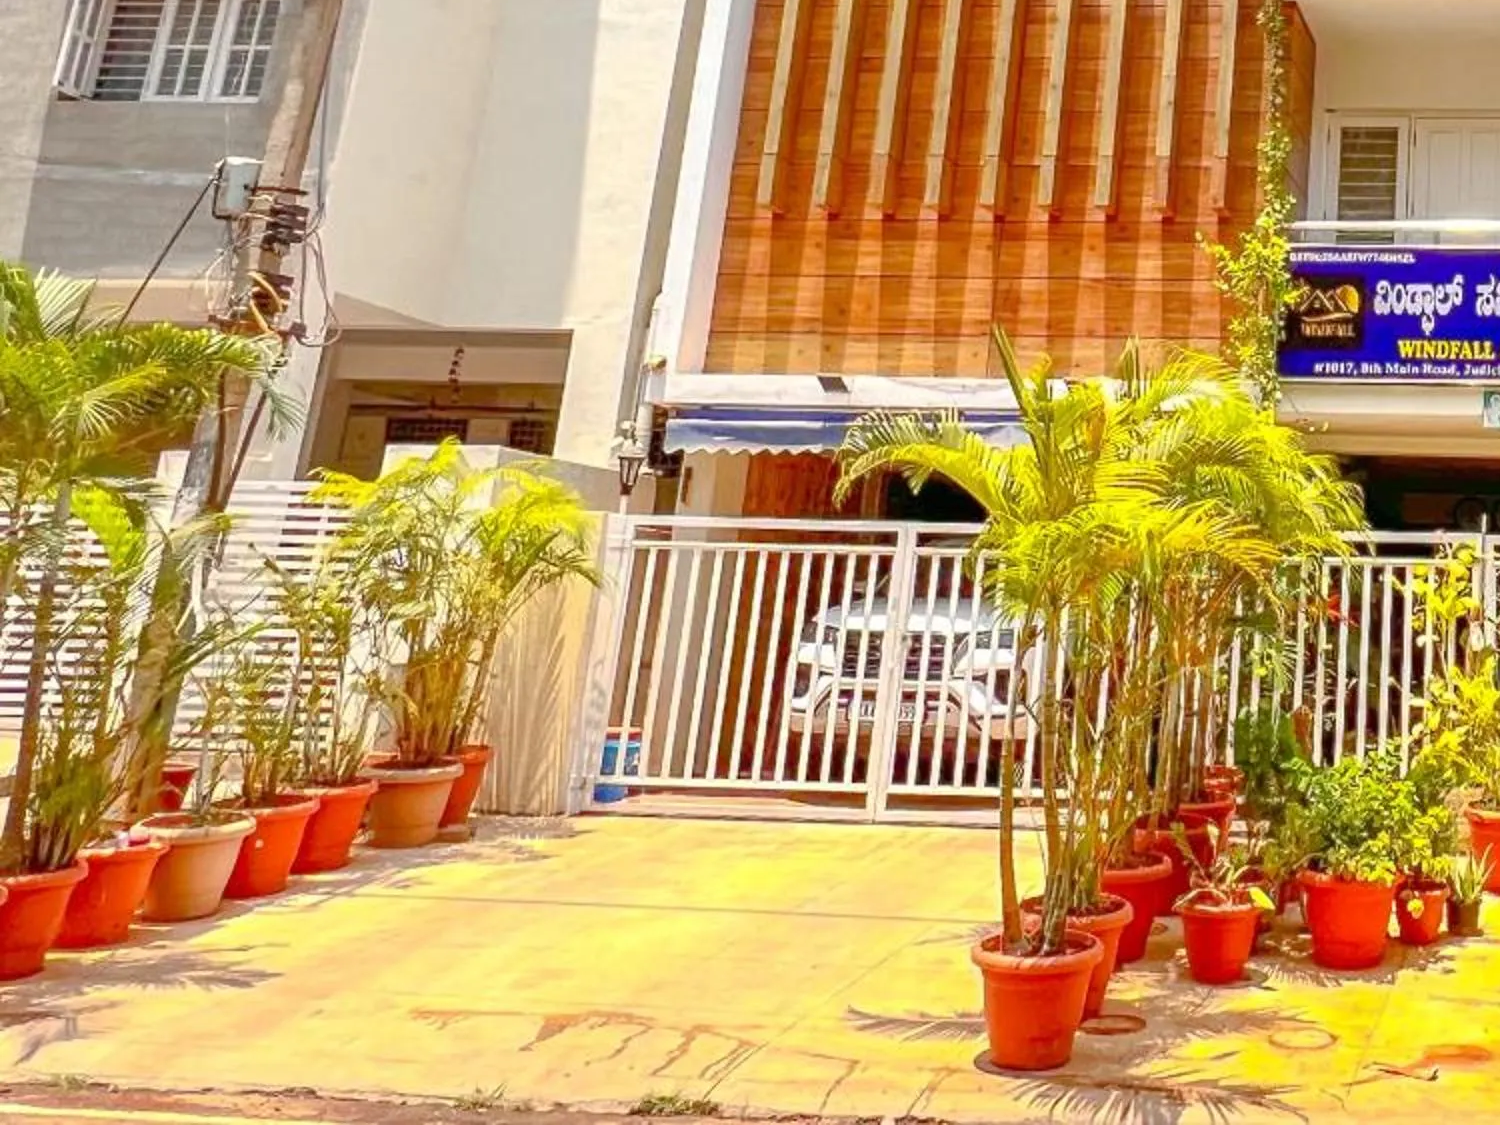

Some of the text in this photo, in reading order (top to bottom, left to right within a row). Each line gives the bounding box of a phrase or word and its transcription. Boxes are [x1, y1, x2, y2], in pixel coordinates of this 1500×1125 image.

[1300, 322, 1357, 338] WINDFALL
[1397, 339, 1496, 361] WINDFALL
[1385, 362, 1420, 375] Main
[1423, 363, 1460, 377] Road,
